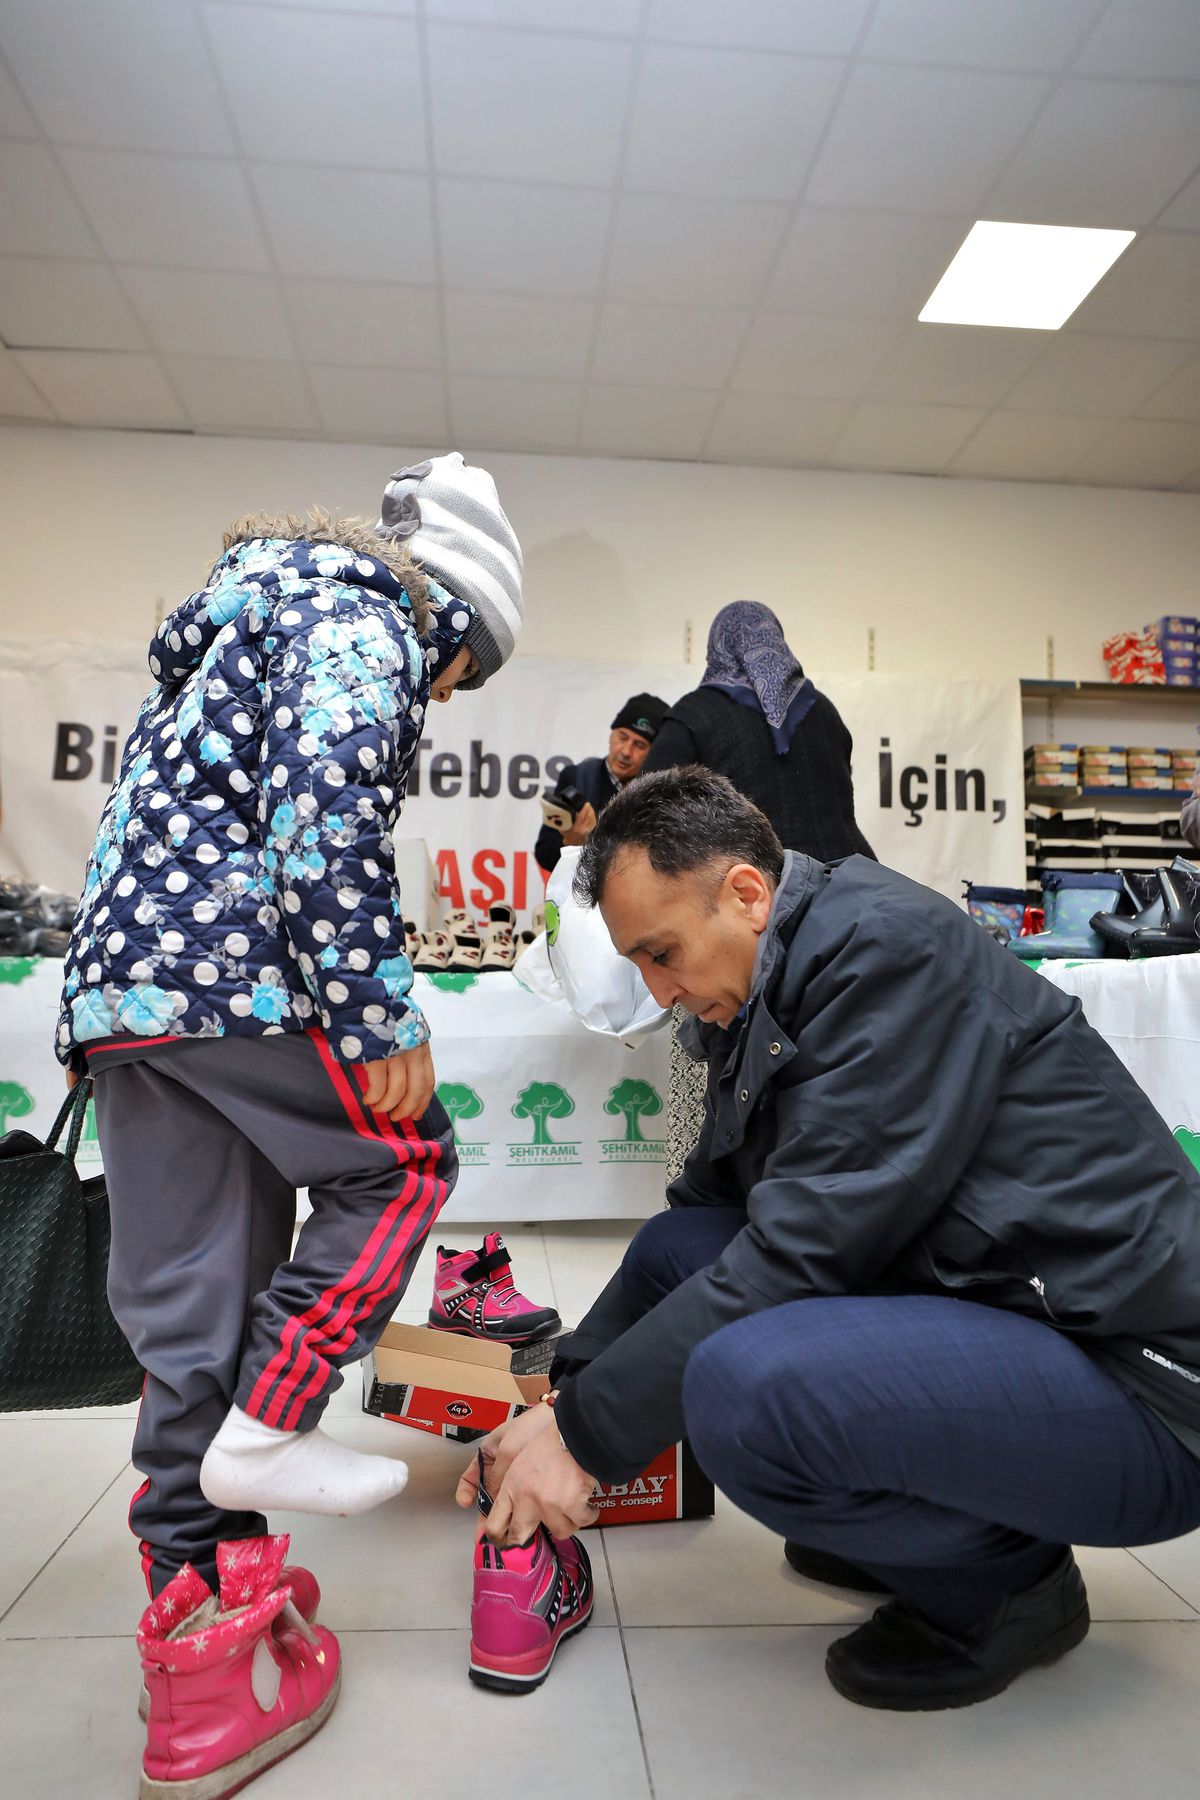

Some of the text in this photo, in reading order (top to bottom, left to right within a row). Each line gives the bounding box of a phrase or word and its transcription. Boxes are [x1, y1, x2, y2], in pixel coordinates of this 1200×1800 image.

[406, 739, 586, 800] Tebes
[878, 737, 1007, 827] İçin,
[436, 849, 552, 927] AŞI
[621, 1495, 663, 1506] consept
